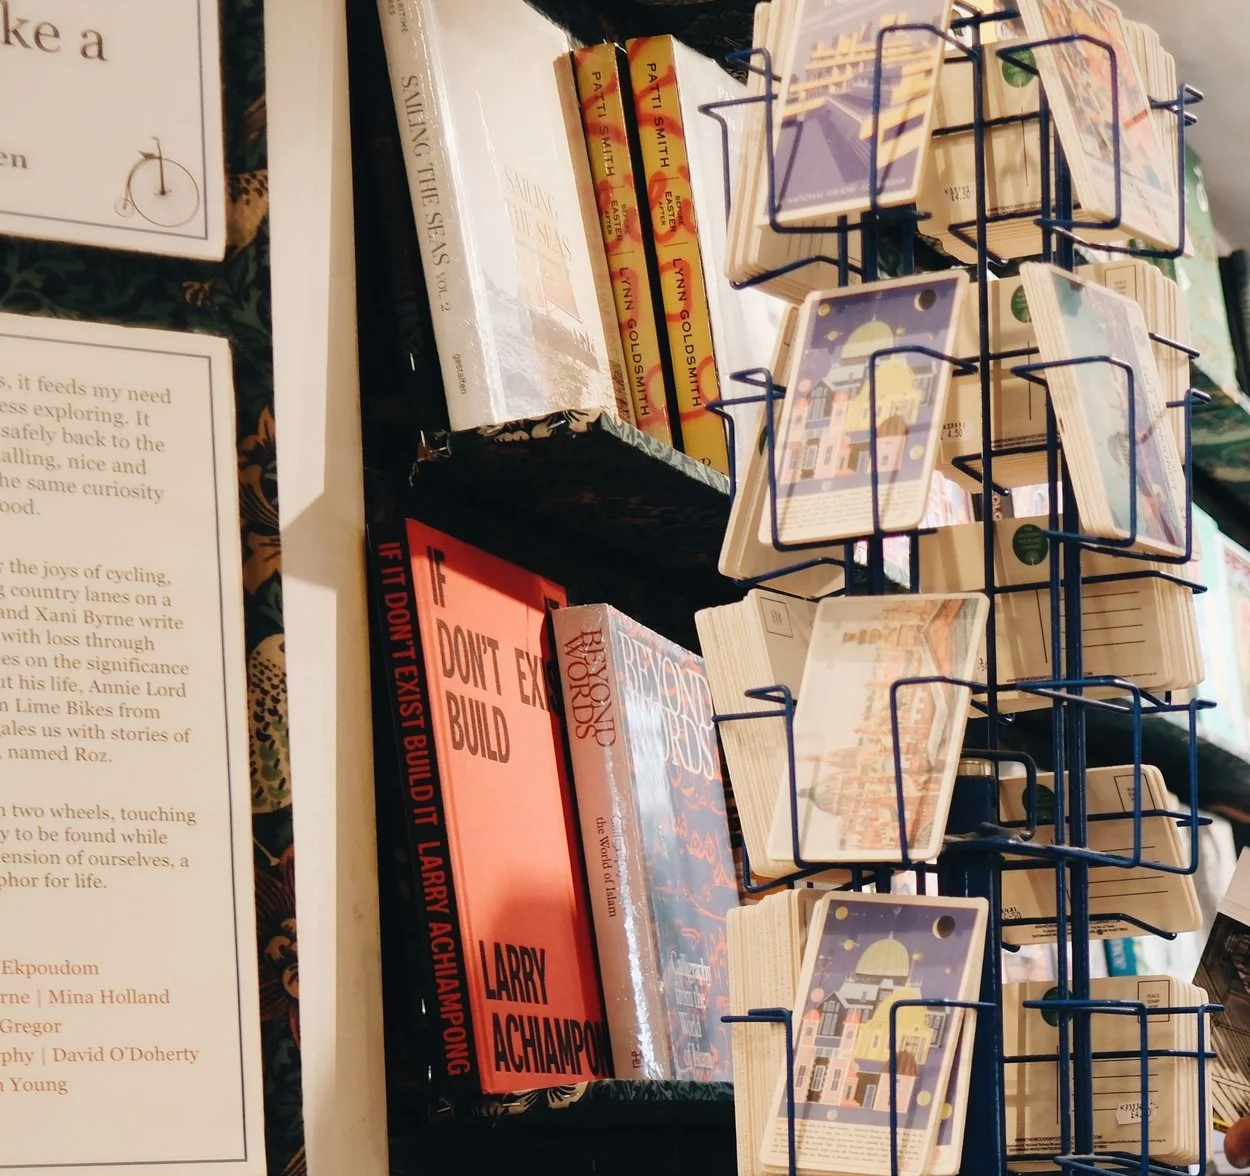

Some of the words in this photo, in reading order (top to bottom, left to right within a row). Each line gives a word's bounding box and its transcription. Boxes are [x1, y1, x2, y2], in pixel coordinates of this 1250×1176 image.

[0, 0, 61, 54] ke
[80, 28, 108, 62] a
[647, 62, 662, 112] PATTI
[401, 75, 432, 158] SAILING
[592, 71, 607, 121] PATTI
[600, 126, 616, 177] SMITH
[654, 118, 670, 169] SMITH
[417, 163, 444, 209] THE
[604, 211, 612, 235] AFTER
[611, 199, 623, 241] EASTER
[665, 191, 676, 232] EASTER
[675, 195, 685, 226] BEFORE
[424, 212, 452, 266] SEAS
[440, 303, 452, 312] 2
[619, 267, 633, 311] LYNN
[627, 318, 650, 416] GOLDSMITH
[672, 258, 687, 301] LYNN
[680, 309, 702, 407] GOLDSMITH
[18, 373, 30, 391] it
[37, 375, 87, 396] feeds
[93, 384, 122, 403] my
[127, 388, 172, 405] need
[452, 353, 468, 395] gestalten
[33, 403, 129, 429] exploring.
[135, 410, 151, 427] It
[1, 423, 56, 446] safely
[62, 427, 106, 448] back
[111, 434, 130, 449] to
[136, 435, 165, 453] the
[68, 454, 106, 471] nice
[112, 459, 147, 475] and
[27, 478, 77, 494] same
[82, 481, 164, 504] curiosity
[377, 541, 402, 561] IF
[10, 558, 38, 575] the
[42, 561, 79, 581] joys
[83, 565, 102, 580] of
[106, 566, 172, 588] cycling,
[381, 566, 406, 586] IT
[427, 544, 446, 608] IF
[10, 586, 80, 604] country
[85, 586, 130, 604] lanes
[135, 594, 157, 607] on
[162, 596, 172, 608] a
[0, 606, 29, 621] and
[35, 606, 77, 624] Xani
[83, 609, 135, 629] Byrne
[138, 614, 184, 631] write
[384, 591, 416, 659] DON'T
[1, 628, 41, 645] with
[46, 629, 80, 647] loss
[86, 632, 156, 655] through
[25, 656, 48, 669] on
[53, 653, 81, 670] the
[86, 657, 190, 676] significance
[436, 618, 502, 696] DON'T
[18, 675, 46, 691] his
[50, 675, 84, 695] life,
[88, 679, 141, 696] Annie
[146, 681, 187, 698] Lord
[563, 638, 596, 740] WORDS
[581, 629, 617, 748] BEYOND
[618, 630, 715, 731] BEYOND
[15, 698, 61, 715] Lime
[66, 700, 114, 718] Bikes
[119, 702, 161, 720] from
[395, 666, 424, 728] EXIST
[42, 724, 62, 738] us
[67, 724, 106, 741] with
[111, 727, 169, 744] stories
[174, 728, 192, 743] of
[445, 690, 510, 764] BUILD
[8, 746, 69, 762] named
[75, 746, 113, 763] Roz.
[404, 734, 434, 803] BUILD
[12, 803, 45, 818] two
[50, 803, 115, 822] wheels,
[120, 806, 197, 826] touching
[413, 806, 438, 826] IT
[595, 817, 606, 835] the
[15, 827, 33, 841] to
[38, 826, 59, 842] be
[64, 827, 116, 843] found
[121, 828, 168, 845] while
[1, 850, 62, 866] ension
[66, 850, 84, 866] of
[88, 851, 175, 869] ourselves,
[180, 858, 190, 868] a
[599, 836, 612, 869] World
[44, 872, 69, 888] for
[75, 873, 107, 889] life.
[417, 840, 449, 913] LARRY
[603, 873, 615, 885] of
[606, 887, 617, 918] Islam
[1, 959, 100, 979] Ekpoudom
[478, 940, 548, 1005] LARRY
[48, 989, 94, 1005] Mina
[100, 988, 170, 1005] Holland
[428, 921, 471, 1076] ACHIAMPONG
[0, 1018, 62, 1037] Gregor
[52, 1046, 105, 1063] David
[109, 1046, 200, 1065] O'Doherty
[9, 1077, 68, 1096] Young
